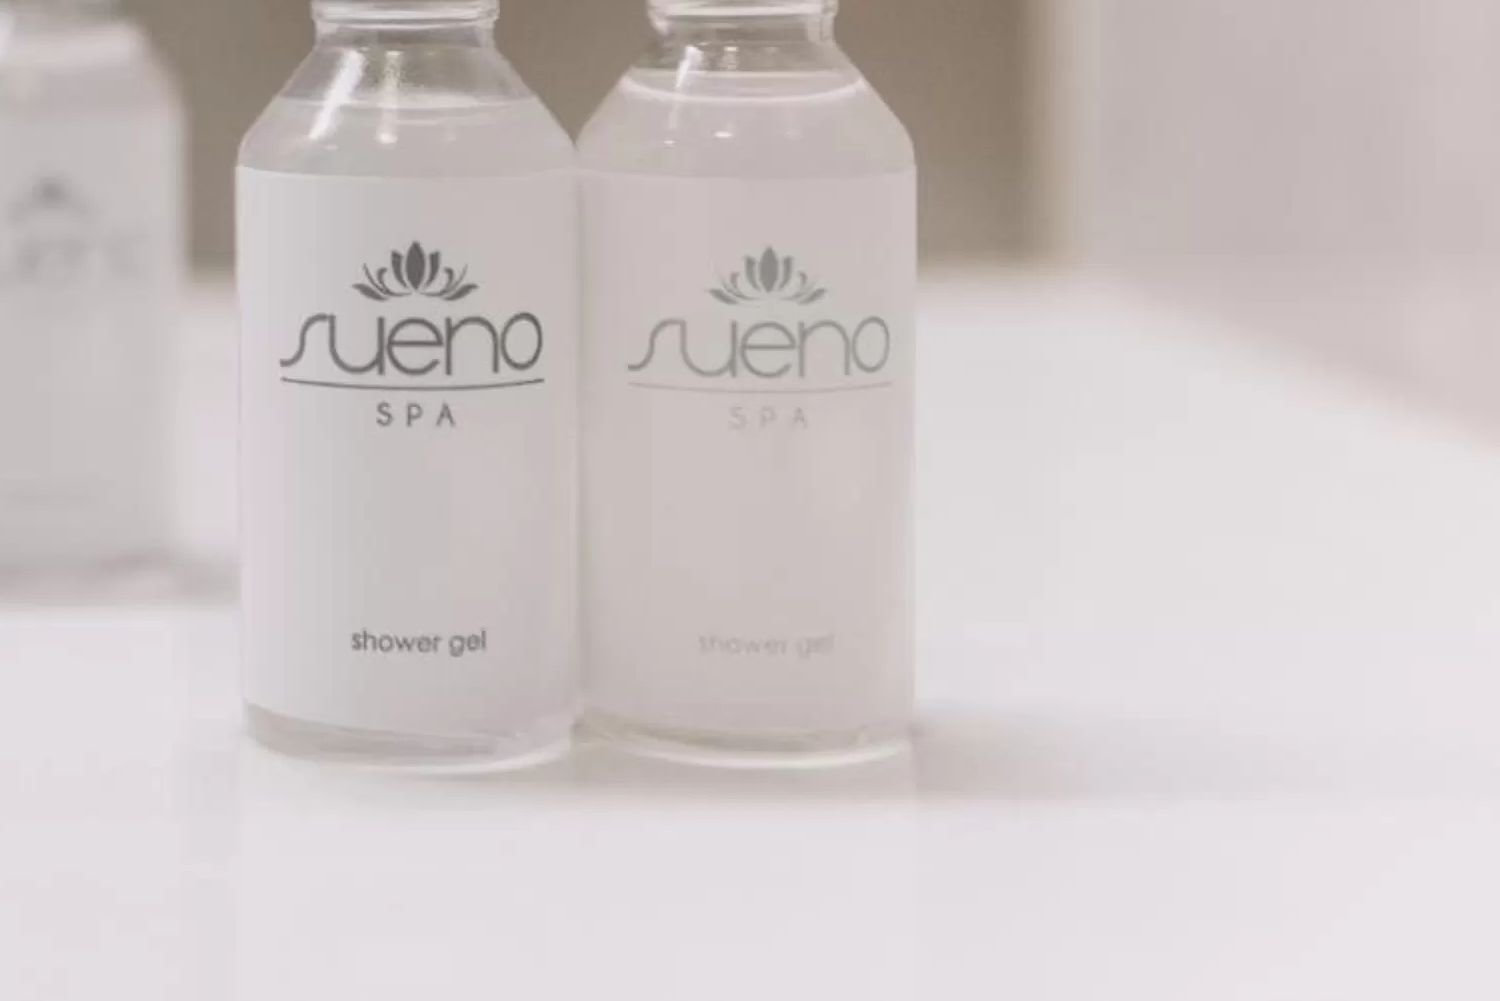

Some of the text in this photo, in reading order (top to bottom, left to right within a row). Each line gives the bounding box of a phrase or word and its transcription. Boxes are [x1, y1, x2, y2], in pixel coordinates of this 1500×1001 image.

[280, 311, 544, 376] sueno
[628, 316, 891, 378] sueno
[376, 402, 456, 427] SPA
[729, 406, 808, 430] SPA
[350, 628, 487, 657] shower gel
[698, 633, 835, 660] shower gel
